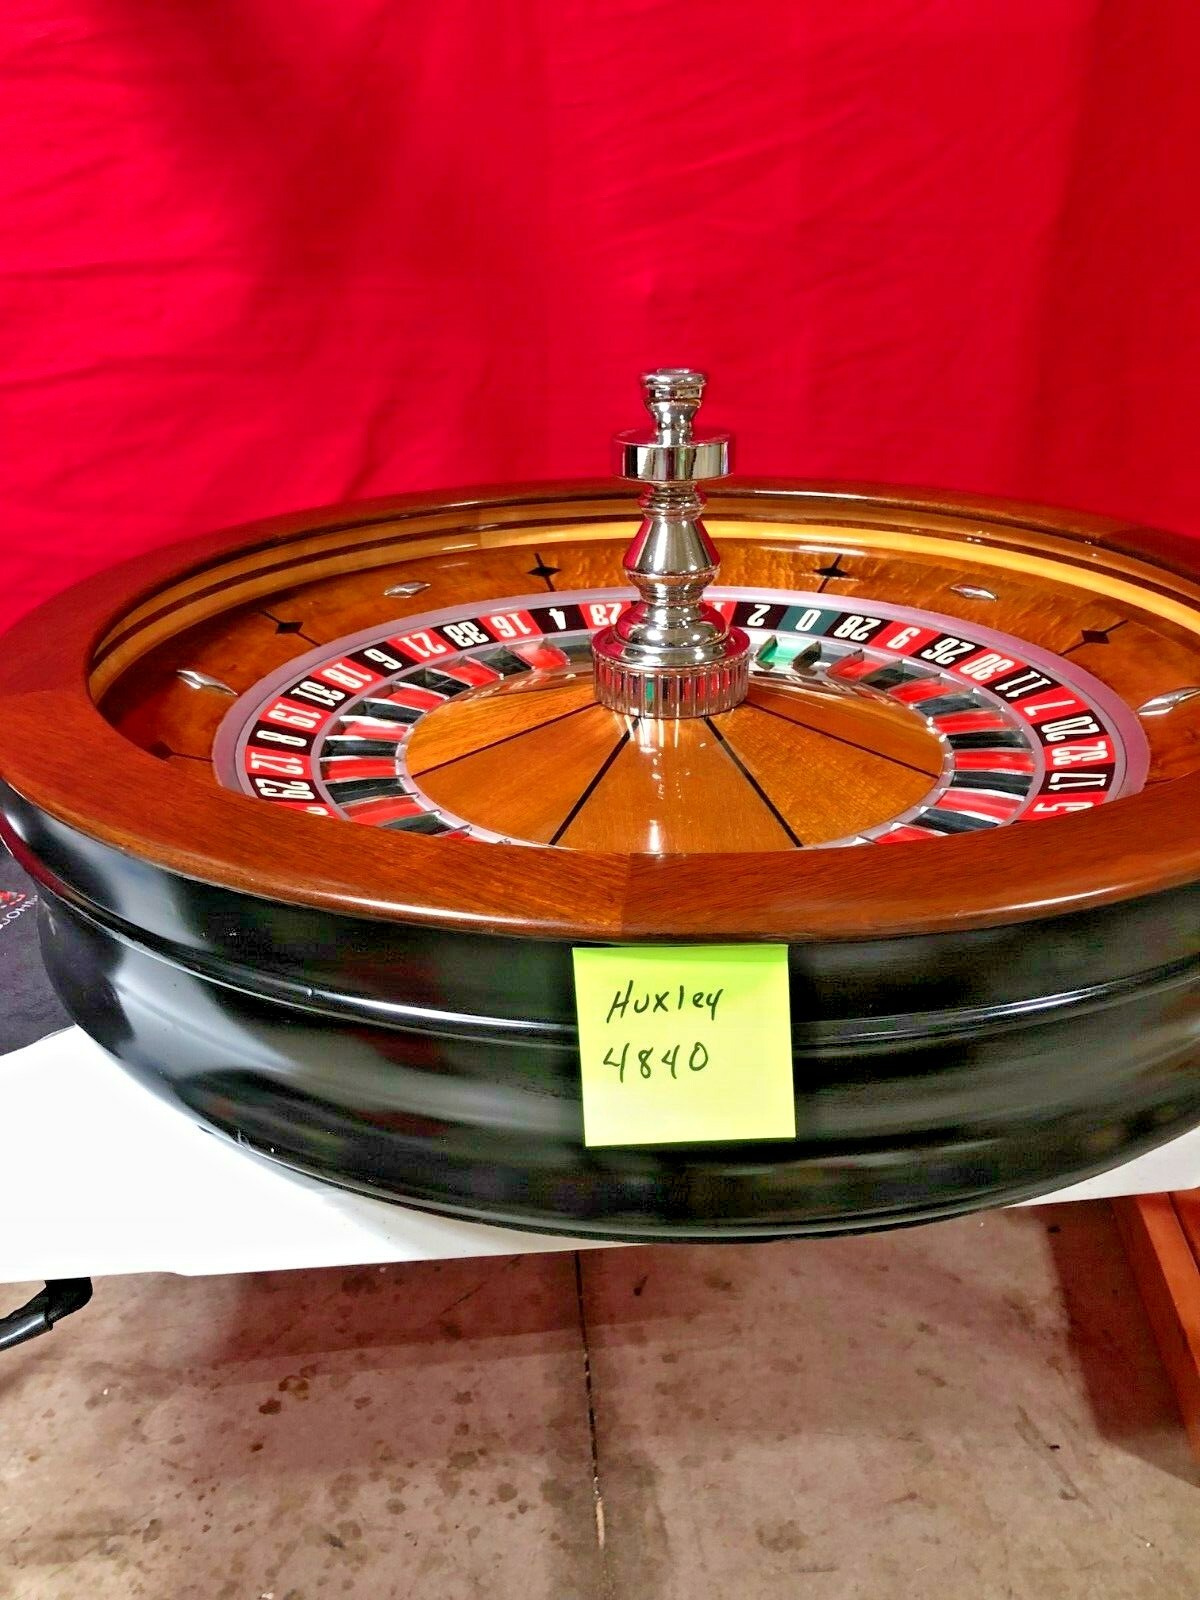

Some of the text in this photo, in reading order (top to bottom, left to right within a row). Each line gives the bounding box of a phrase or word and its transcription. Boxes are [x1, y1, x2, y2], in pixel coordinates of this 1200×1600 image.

[491, 612, 532, 638] 16
[549, 608, 567, 630] 4
[590, 603, 622, 625] 23
[747, 604, 771, 627] 2
[795, 609, 821, 632] 0
[442, 621, 490, 647] 33
[833, 615, 882, 641] 28
[886, 628, 921, 650] 9
[398, 633, 447, 658] 21
[920, 637, 975, 665] 26
[363, 648, 402, 670] 6
[959, 653, 1015, 680] 30
[320, 662, 373, 689] 18
[994, 670, 1052, 697] 11
[290, 681, 346, 707] 31
[267, 702, 322, 729] 19
[1024, 699, 1076, 716] 7
[256, 730, 308, 747] 8
[1041, 715, 1100, 741] 20
[250, 752, 305, 775] 12
[1051, 741, 1109, 766] 32
[255, 778, 316, 800] 29
[1048, 772, 1109, 791] 17
[606, 979, 724, 1024] Huxley
[602, 1040, 710, 1083] 4840
